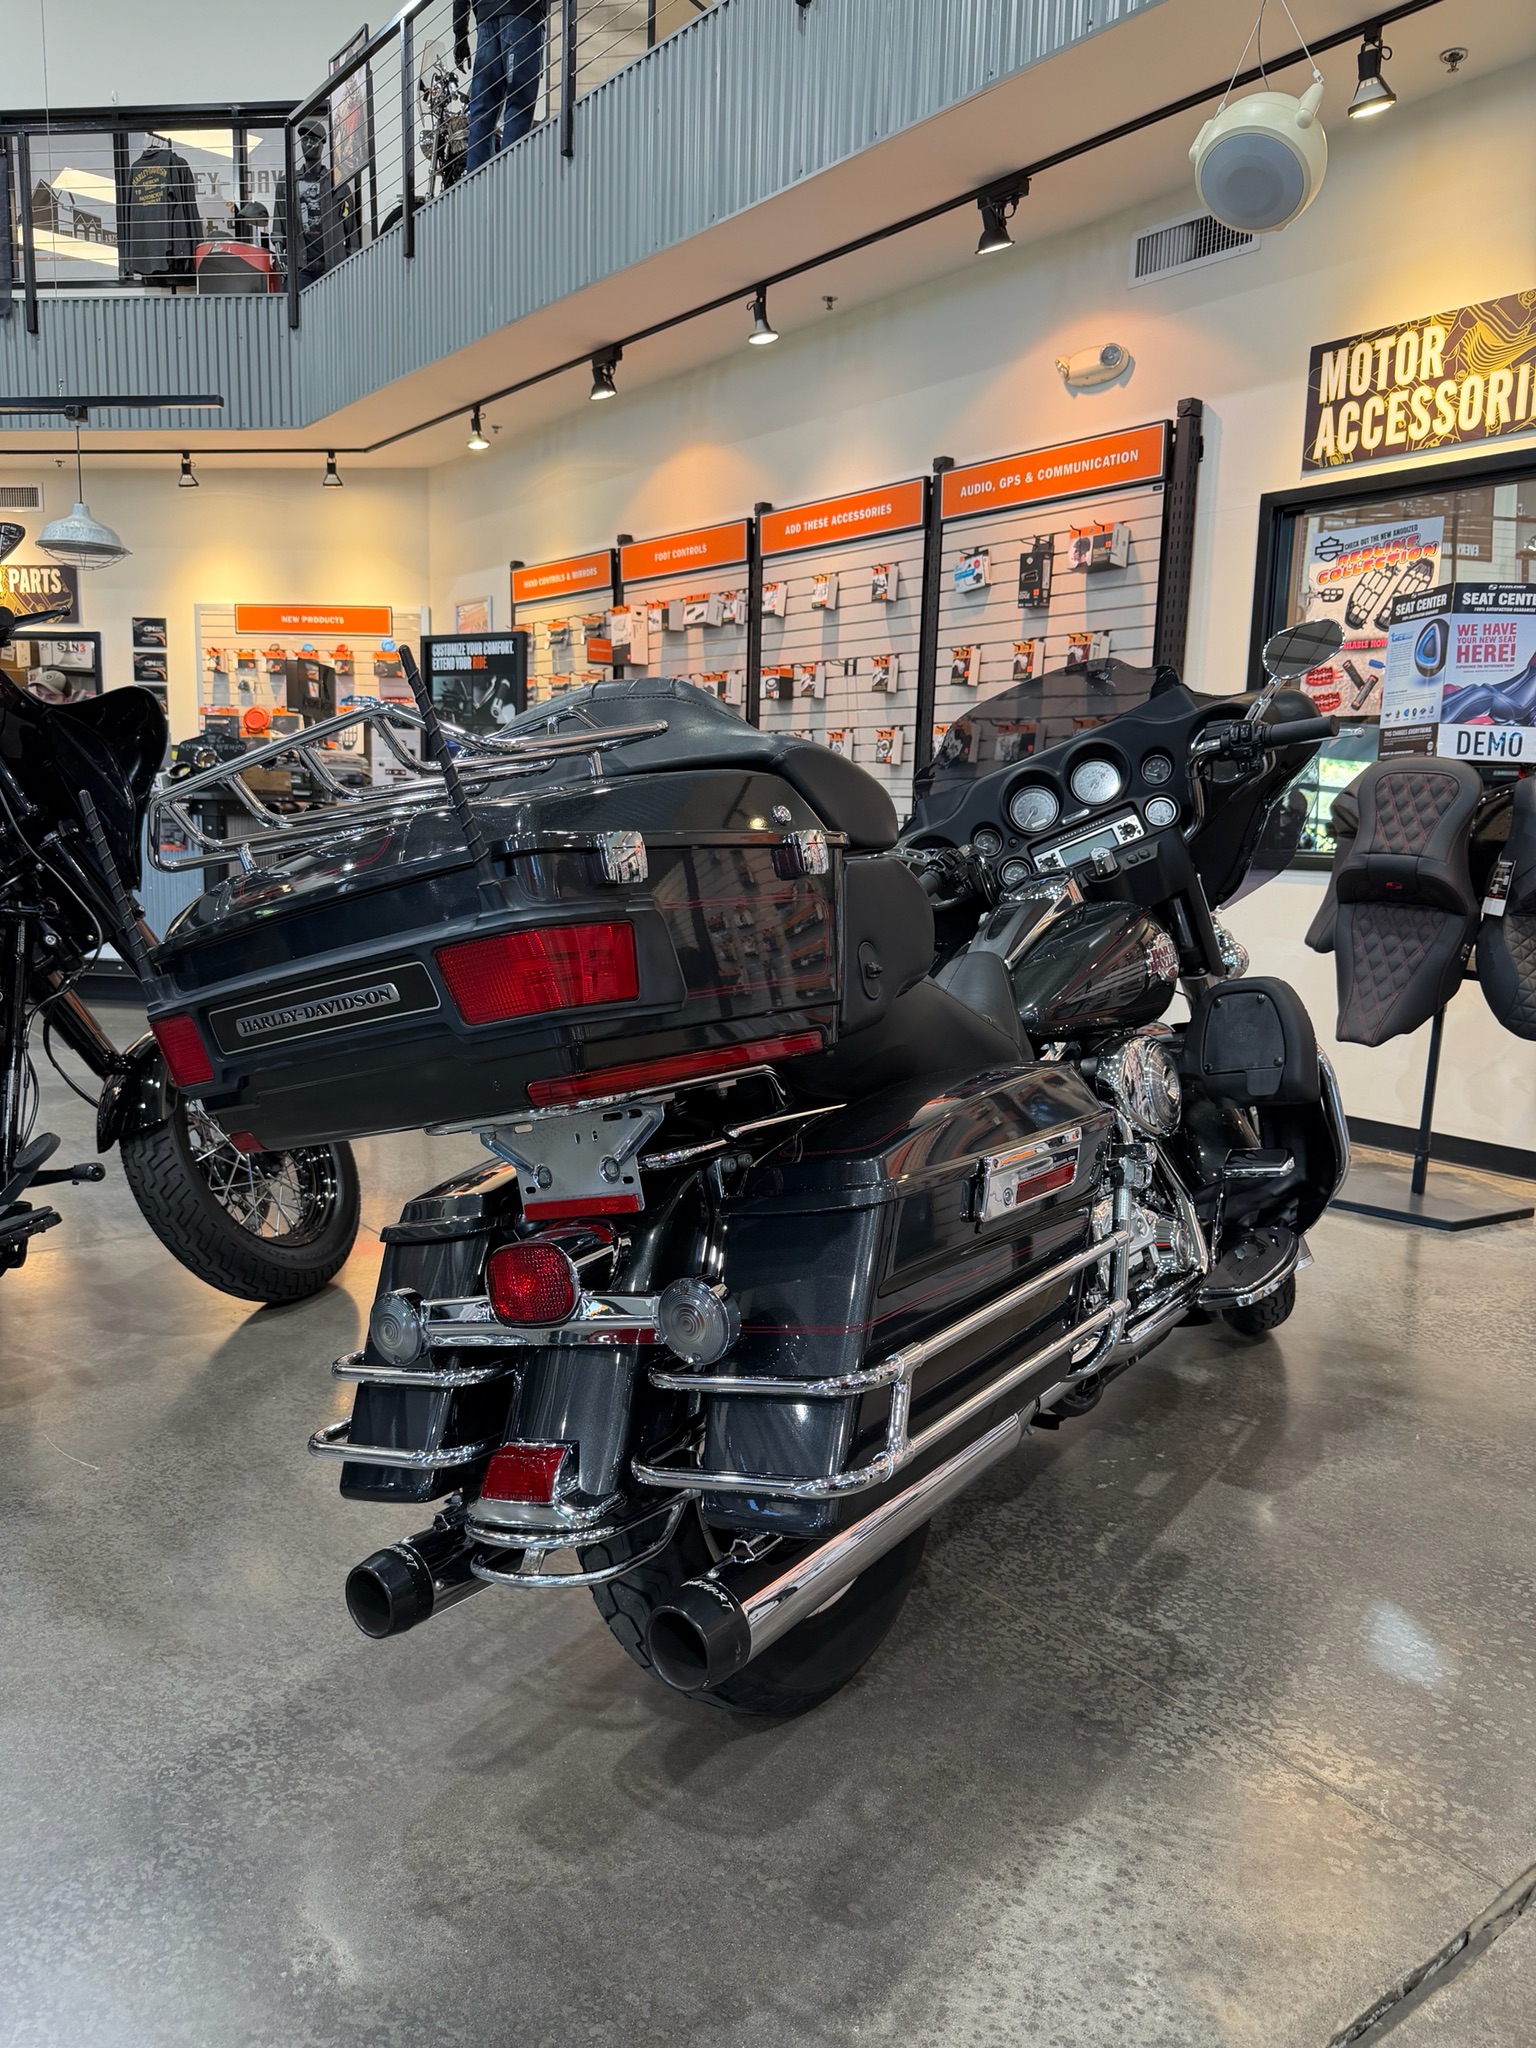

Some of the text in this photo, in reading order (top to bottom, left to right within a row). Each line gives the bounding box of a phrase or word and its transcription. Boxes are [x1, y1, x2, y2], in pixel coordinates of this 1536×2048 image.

[1319, 325, 1446, 405] MOTOR
[1313, 362, 1536, 460] ACCESSORI
[960, 449, 1139, 498] AUDIO, GPS & COMMUNICATION
[784, 503, 892, 535] ADD THESE ACCESSORIES
[1337, 533, 1421, 566] REDLINE
[1345, 524, 1418, 550] CHECK OUT THE NEW ANODIZED
[654, 544, 707, 562] FOOT CONTROLS
[1317, 541, 1439, 585] COLLECTION
[8, 568, 62, 594] PARTS
[538, 573, 566, 586] CONTROLS
[571, 567, 598, 579] MIRRORS
[1395, 600, 1416, 616] SEAT
[1416, 593, 1448, 613] CENTER
[1462, 593, 1496, 605] SEAT
[281, 615, 345, 624] NEW PRODUCTS
[1457, 622, 1517, 636] WE HAVE
[432, 640, 514, 657] CUSTOMIZE YOUR COMFORT.
[1456, 643, 1516, 663] HERE!
[432, 657, 456, 671] EXTEND
[455, 656, 472, 670] YOUR
[1457, 731, 1523, 757] DEMO
[240, 988, 392, 1034] HARLEY-DAVIDSON
